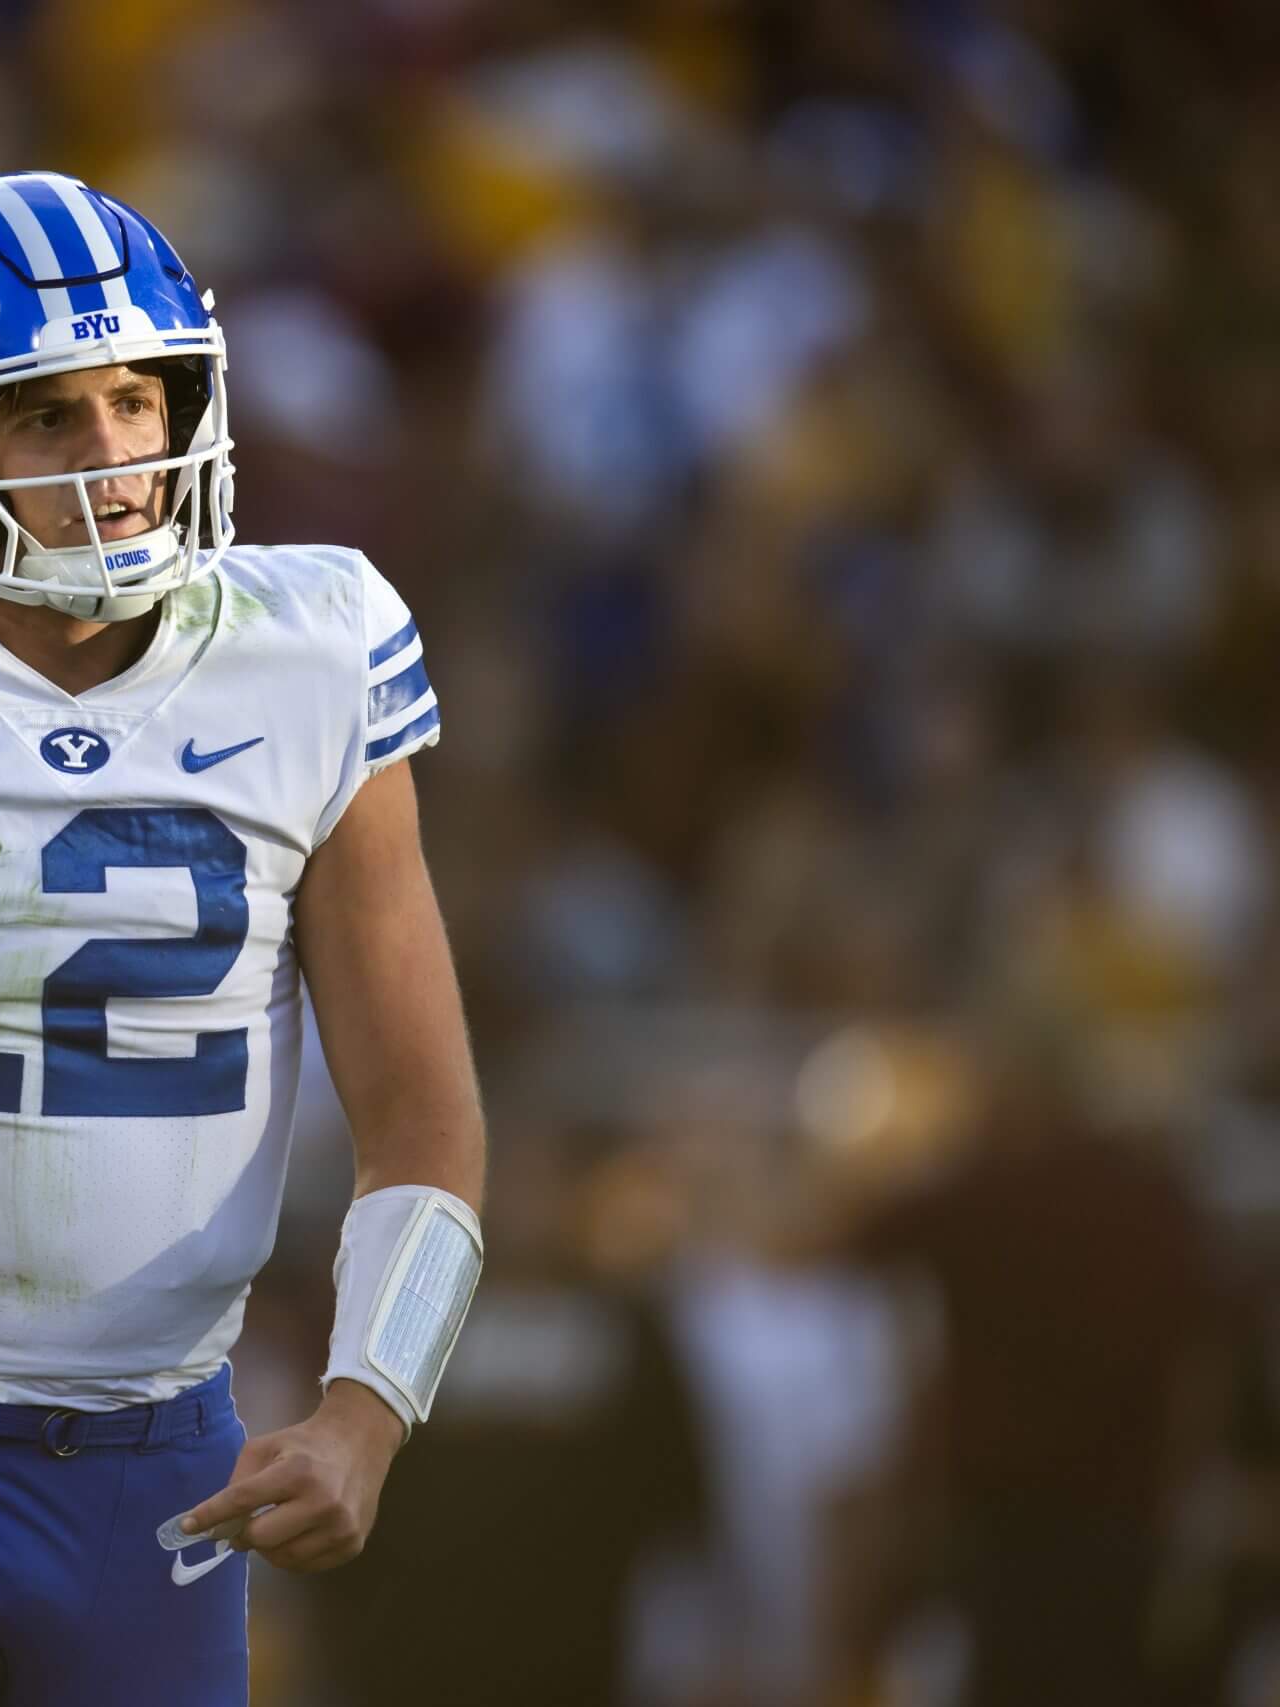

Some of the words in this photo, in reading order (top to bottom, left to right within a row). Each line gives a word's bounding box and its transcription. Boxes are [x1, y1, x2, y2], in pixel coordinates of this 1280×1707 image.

[72, 314, 120, 340] BYU
[104, 555, 114, 571] O
[115, 549, 152, 568] COUGS
[48, 732, 101, 769] Y
